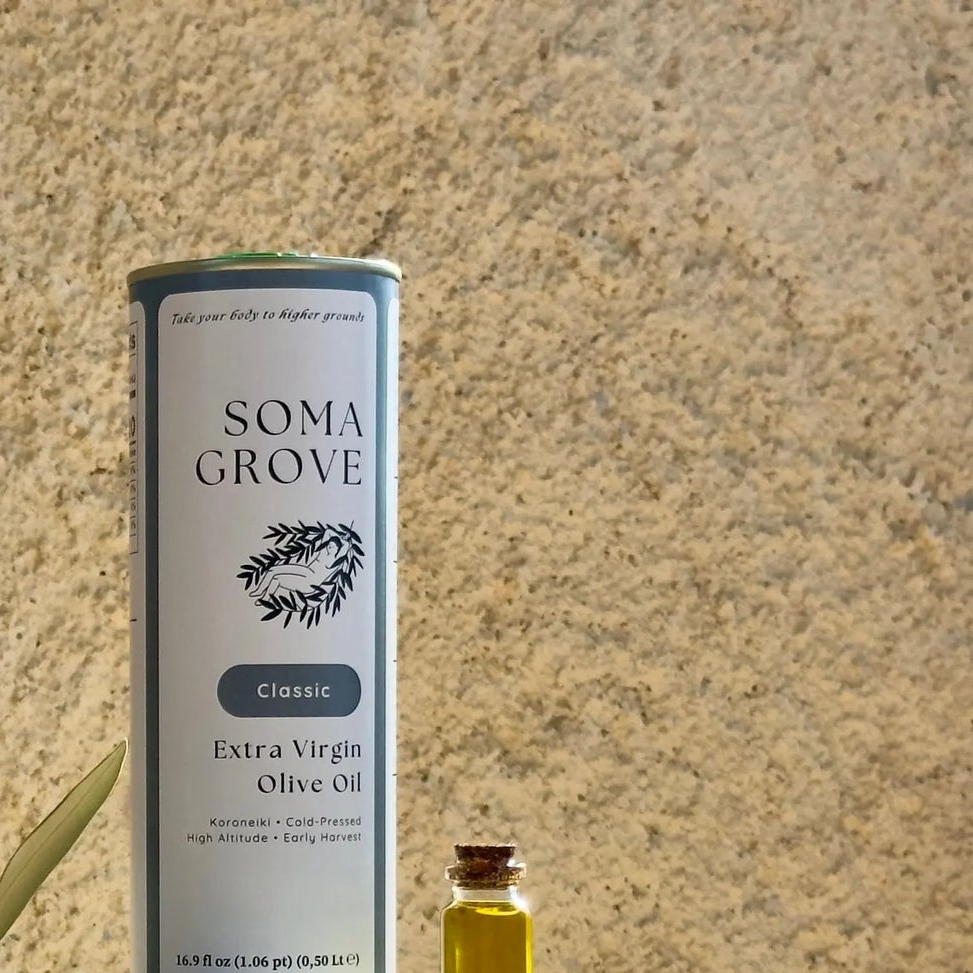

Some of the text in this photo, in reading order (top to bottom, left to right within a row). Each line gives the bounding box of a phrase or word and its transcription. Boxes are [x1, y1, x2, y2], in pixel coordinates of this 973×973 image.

[171, 308, 365, 325] Take your body to higher grounds
[224, 400, 363, 437] SOMA
[195, 448, 362, 486] GROVE
[257, 682, 330, 698] Classic
[214, 739, 361, 764] Extra Virgin
[257, 772, 361, 794] Olive Oil
[209, 816, 362, 828] Koroneiki Cold-Pressed
[187, 832, 362, 844] High Altitude Early Harvest
[176, 954, 200, 967] 16.9
[202, 954, 212, 967] fl
[215, 958, 231, 968] oz
[234, 955, 269, 970] (1.06
[273, 955, 293, 971] pt)
[296, 954, 329, 970] (0,50
